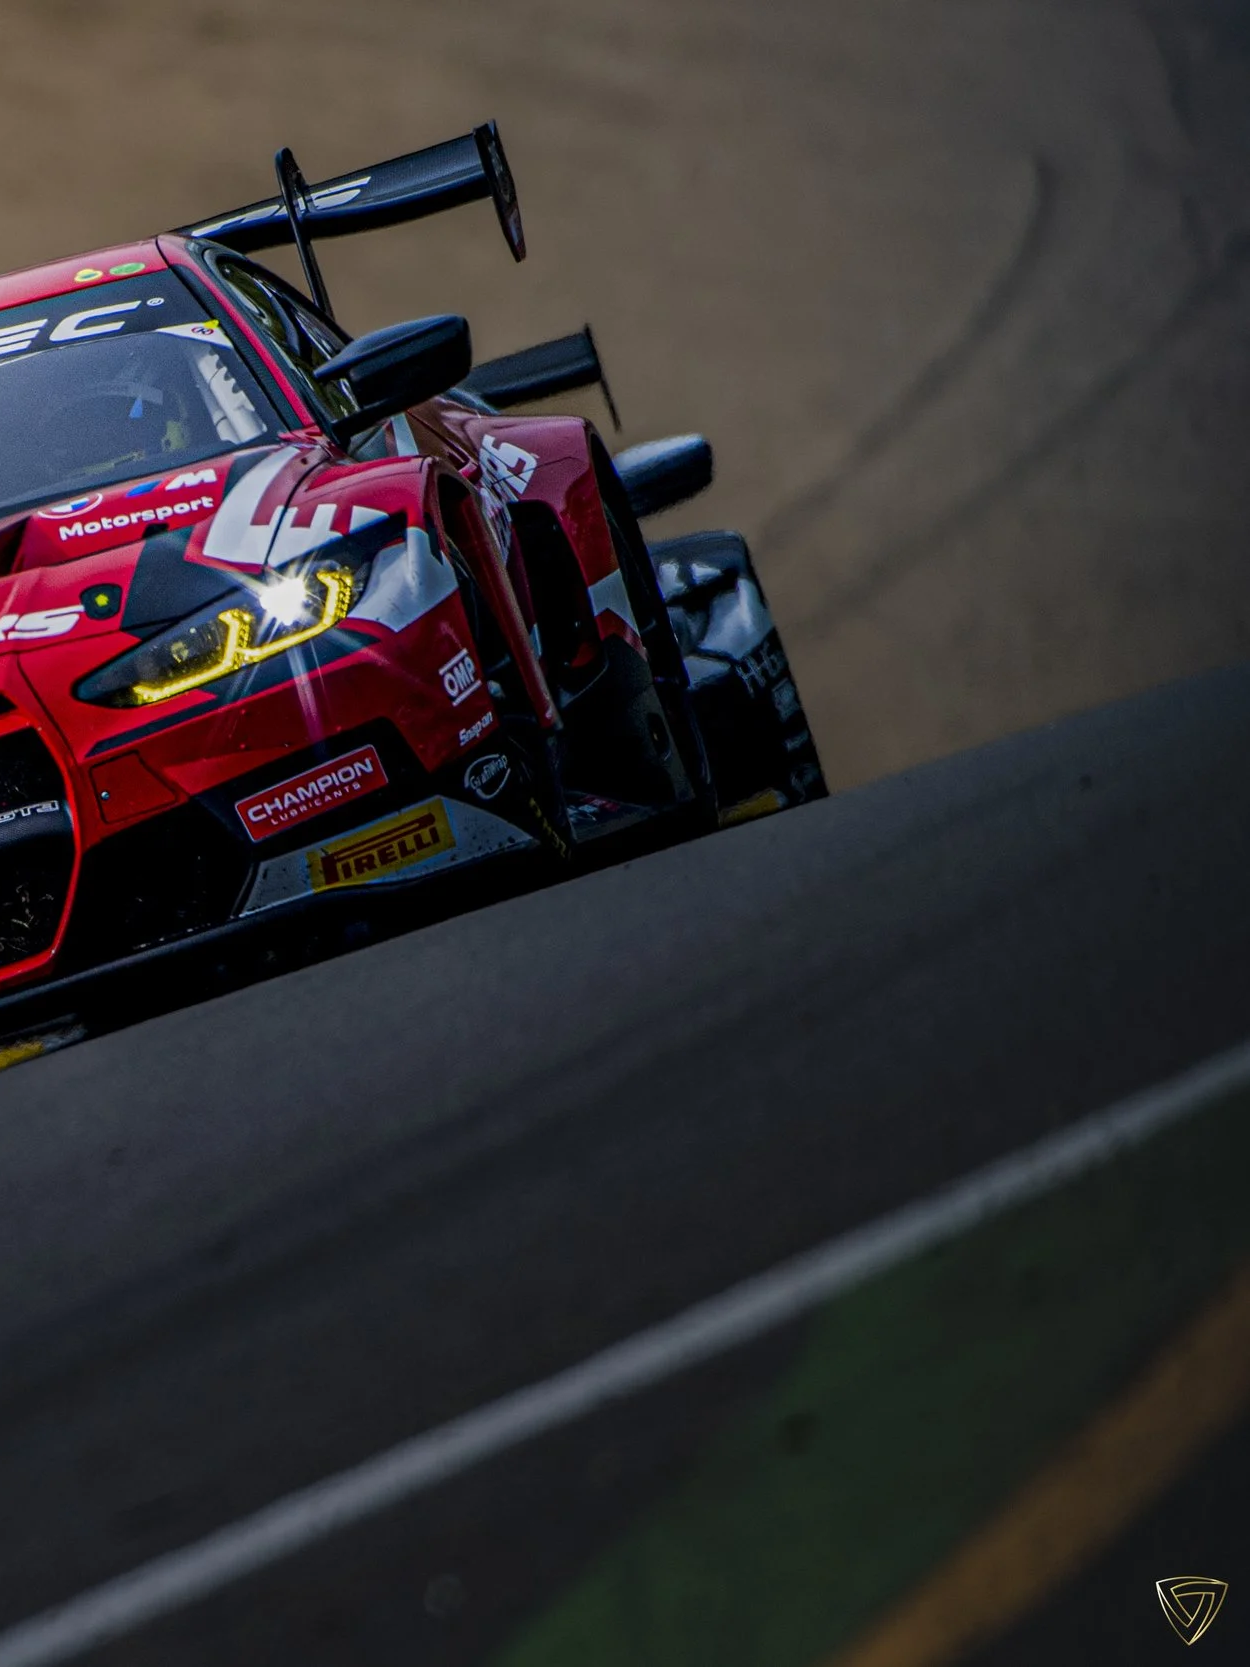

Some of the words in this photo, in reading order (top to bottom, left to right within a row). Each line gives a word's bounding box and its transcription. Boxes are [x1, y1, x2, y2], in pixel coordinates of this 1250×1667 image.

[58, 496, 215, 541] Motorsport
[442, 655, 477, 698] OMP
[246, 757, 374, 823] CHAMPION
[270, 781, 363, 827] LUBRICANTS
[318, 812, 442, 886] PIRELLI
